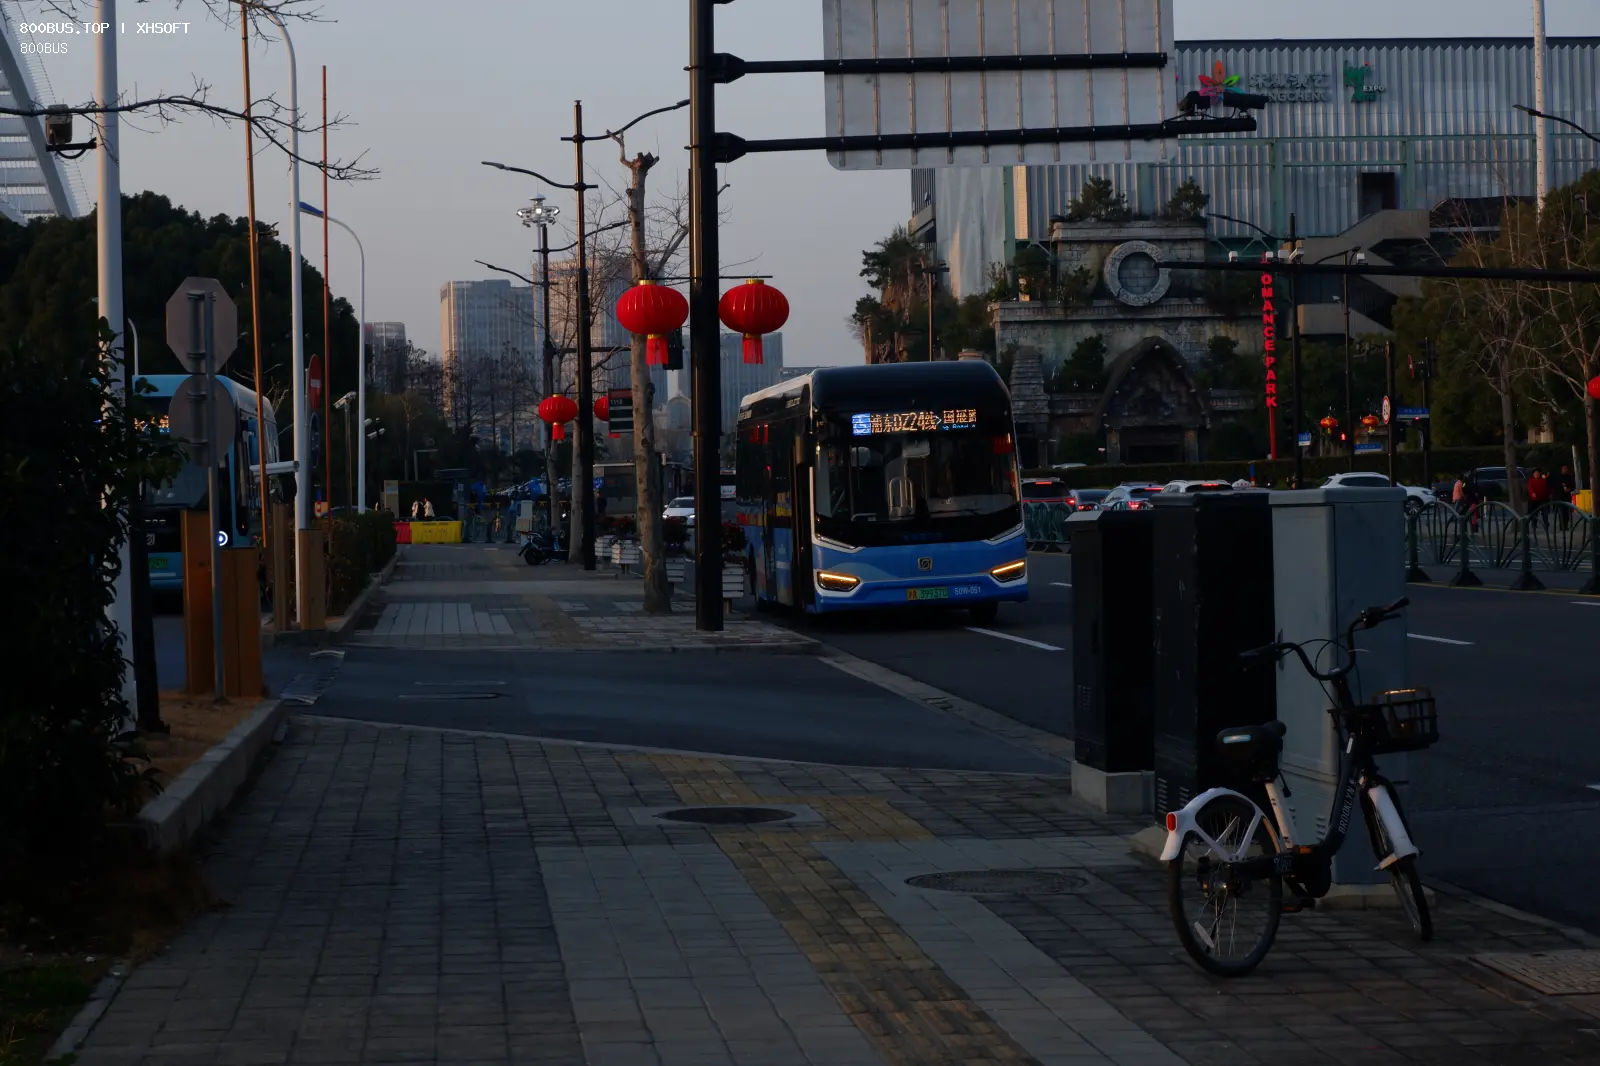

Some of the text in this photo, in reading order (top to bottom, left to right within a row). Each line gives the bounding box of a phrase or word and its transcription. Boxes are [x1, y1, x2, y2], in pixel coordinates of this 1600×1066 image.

[1362, 84, 1385, 93] EXPO
[1265, 356, 1278, 407] PARK
[1338, 785, 1355, 834] BROOKLYN
